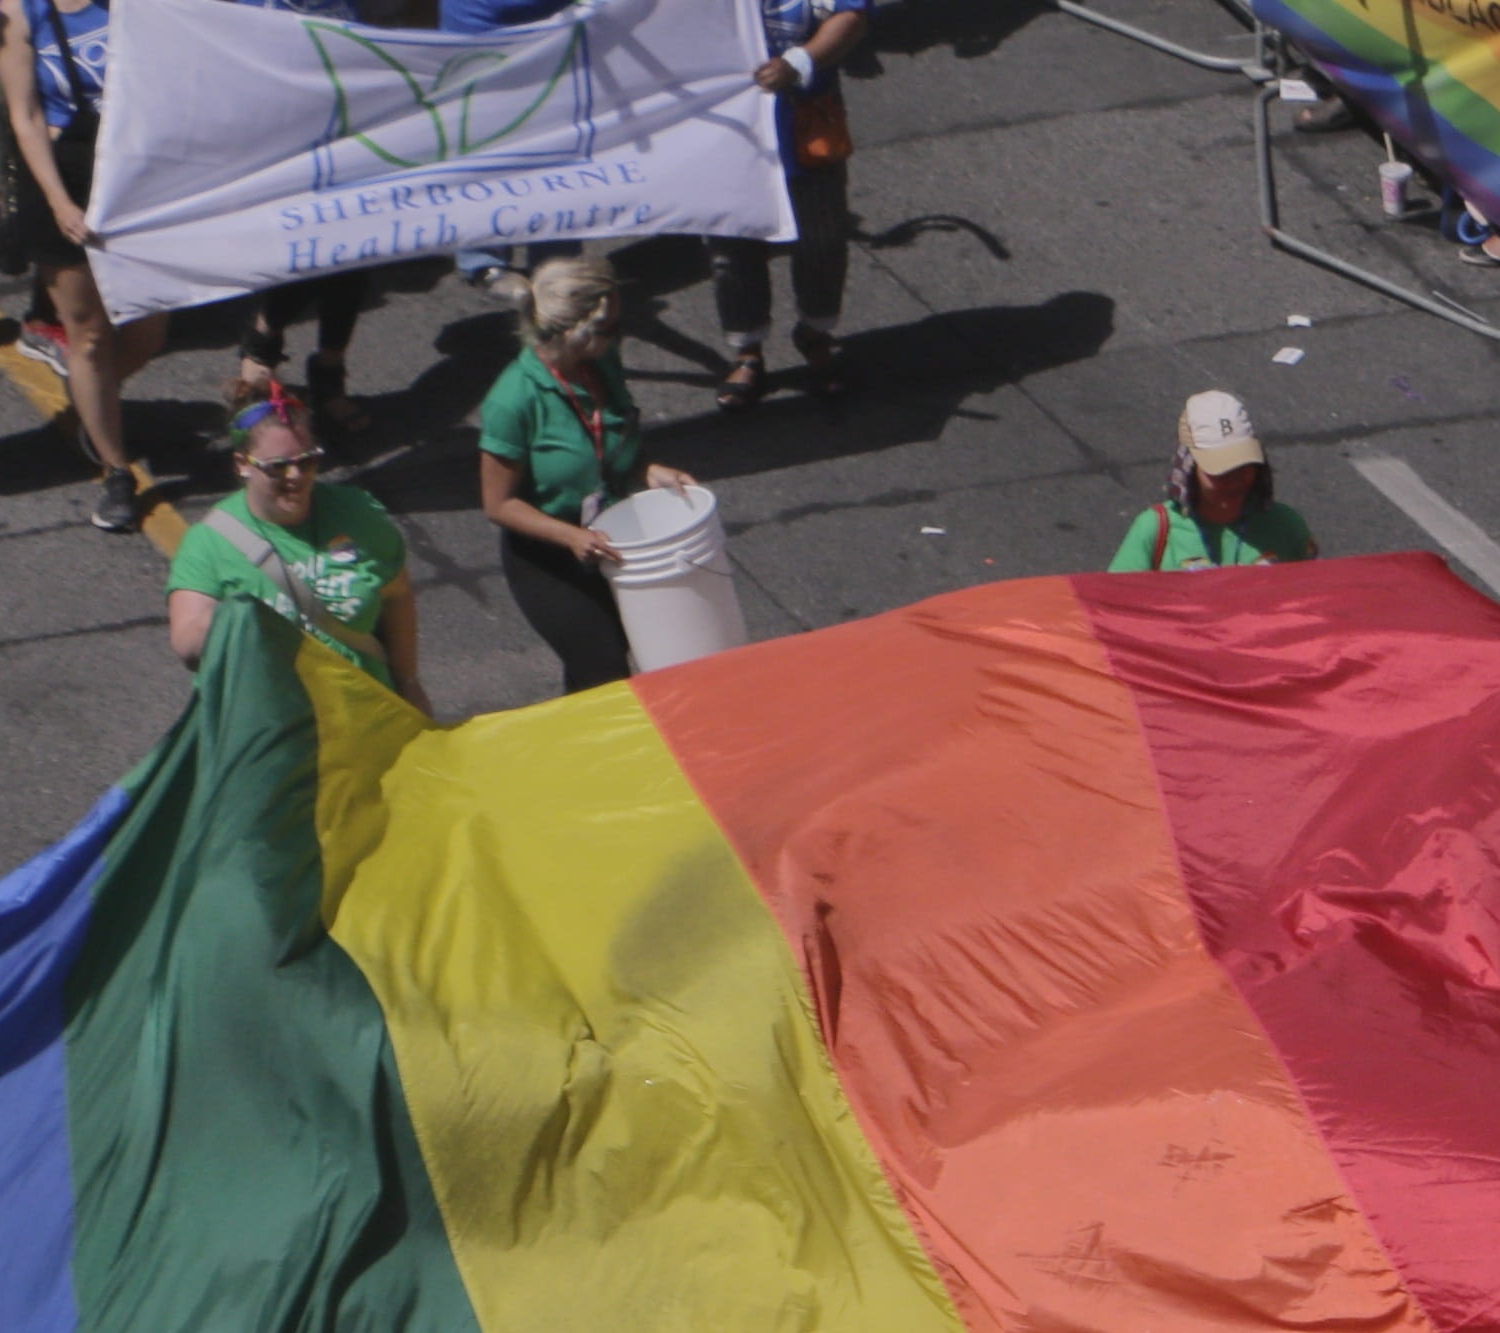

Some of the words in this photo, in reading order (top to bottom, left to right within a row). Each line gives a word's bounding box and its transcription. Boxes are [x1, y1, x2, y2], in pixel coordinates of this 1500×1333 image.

[279, 158, 647, 232] SHERBOURNE
[286, 212, 460, 274] Health
[490, 199, 654, 239] Centre
